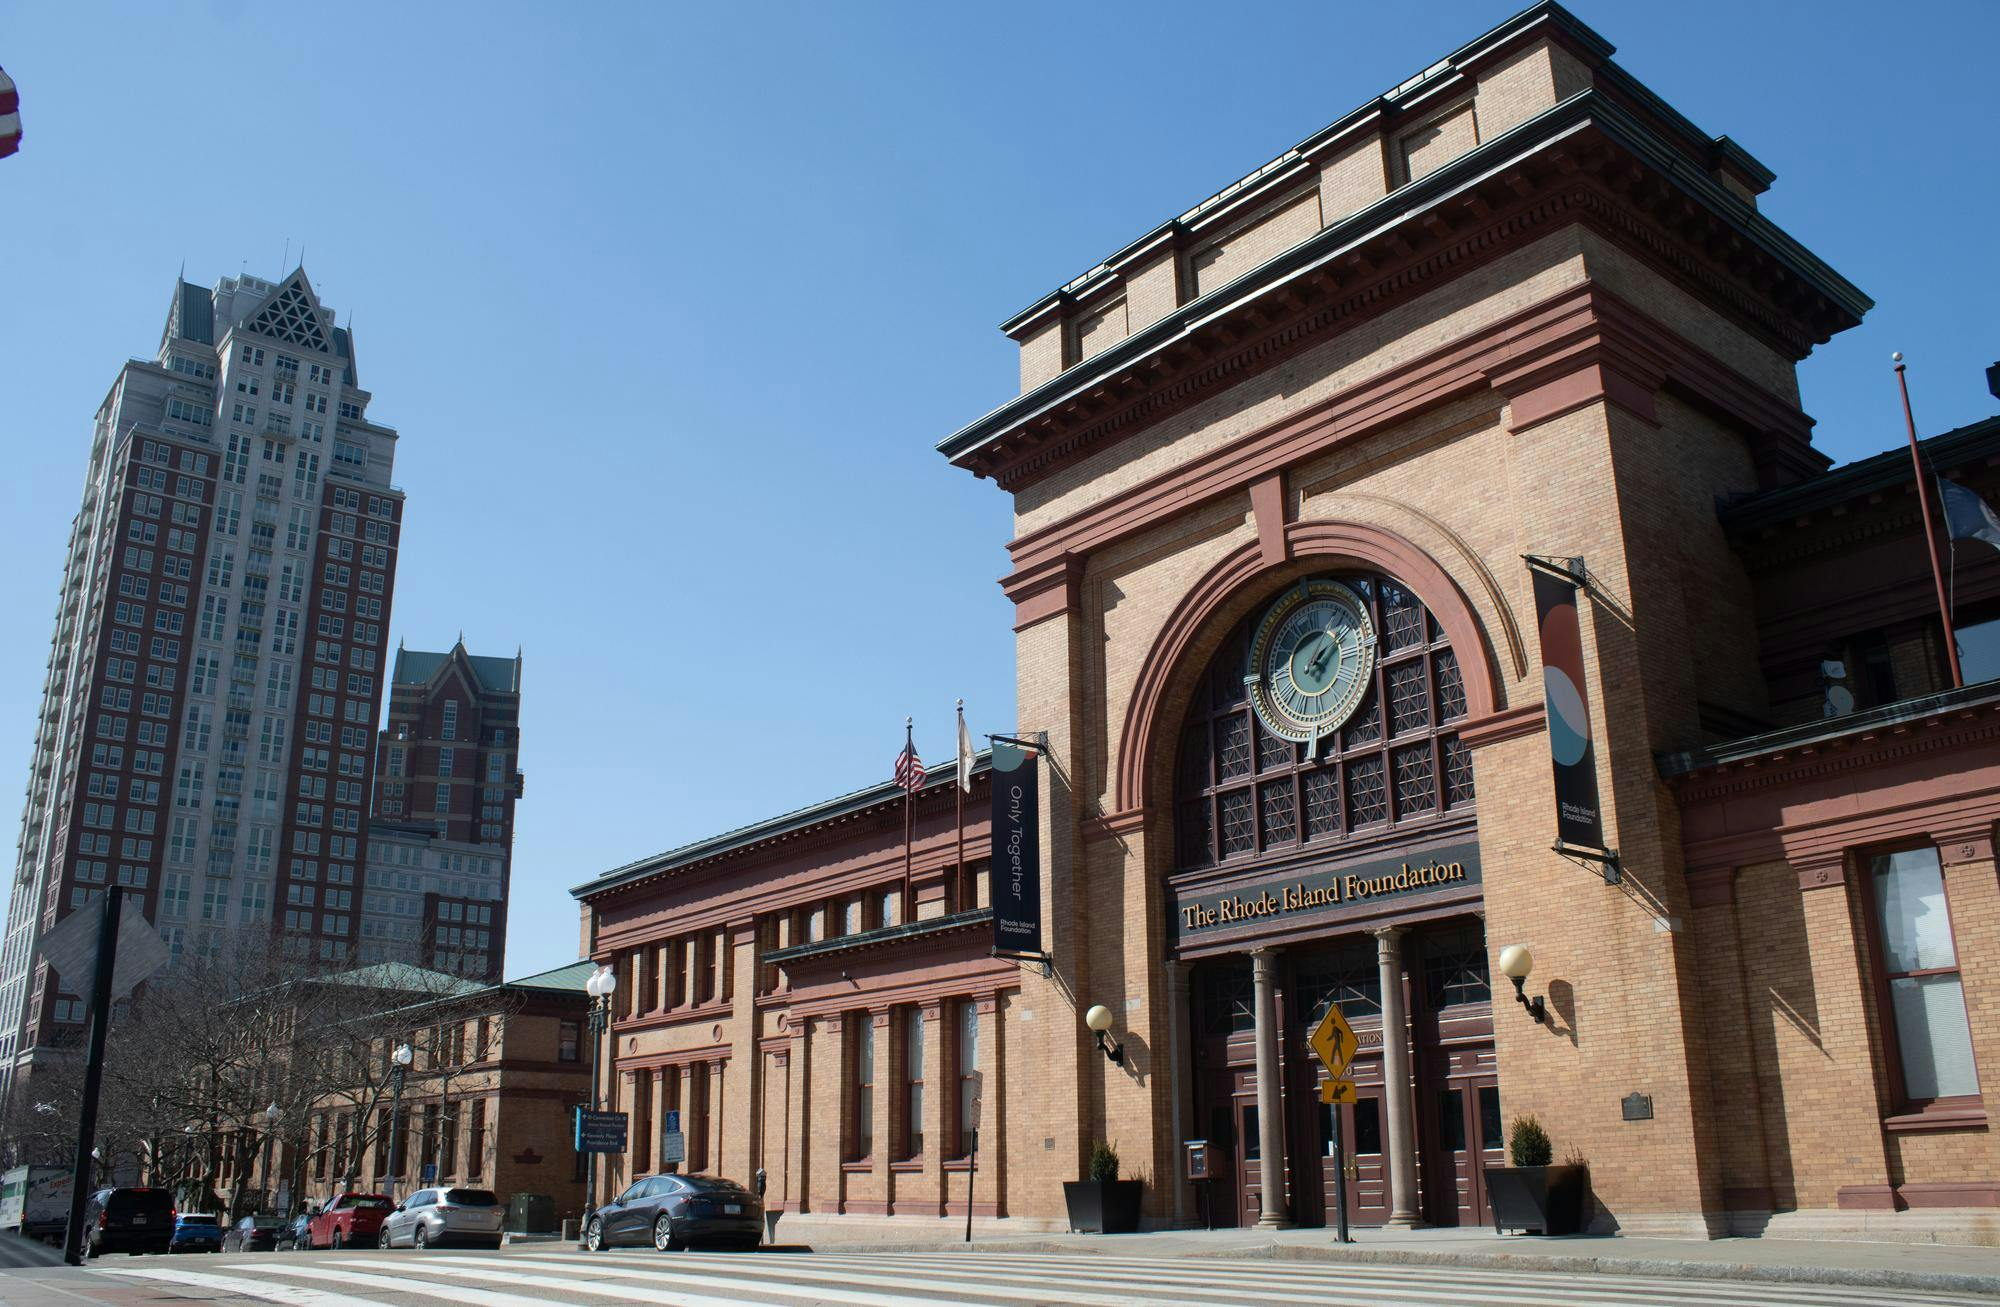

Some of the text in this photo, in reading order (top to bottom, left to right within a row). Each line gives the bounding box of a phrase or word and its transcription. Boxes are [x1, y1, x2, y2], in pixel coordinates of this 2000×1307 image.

[1562, 802, 1595, 817] Rhode Island
[1563, 810, 1592, 824] Foundation
[1007, 785, 1023, 901] Only Together
[1182, 860, 1464, 928] The Rhode Island Foundation
[1000, 918, 1036, 929] Rhode Island
[1000, 925, 1032, 934] Foundation
